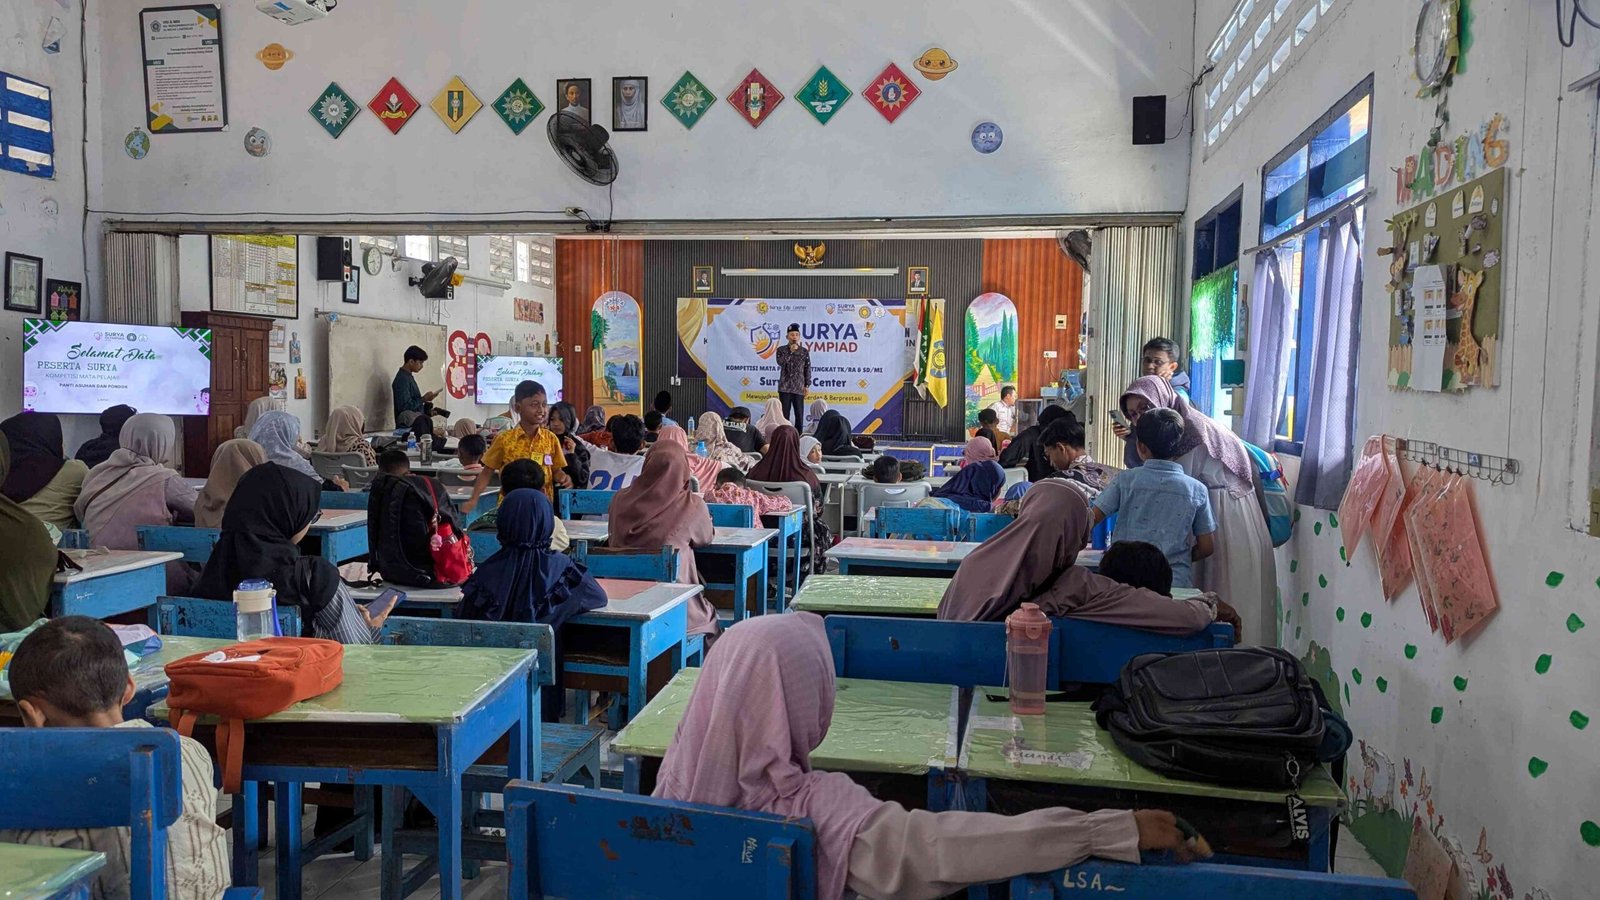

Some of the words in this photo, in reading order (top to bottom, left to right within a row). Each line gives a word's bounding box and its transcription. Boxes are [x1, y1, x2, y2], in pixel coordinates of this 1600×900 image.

[798, 324, 858, 340] URYA
[67, 342, 124, 360] Selamat
[38, 361, 80, 370] PESERTA
[87, 363, 118, 372] SURYA
[812, 378, 846, 388] Center
[1291, 796, 1310, 840] ALVIS
